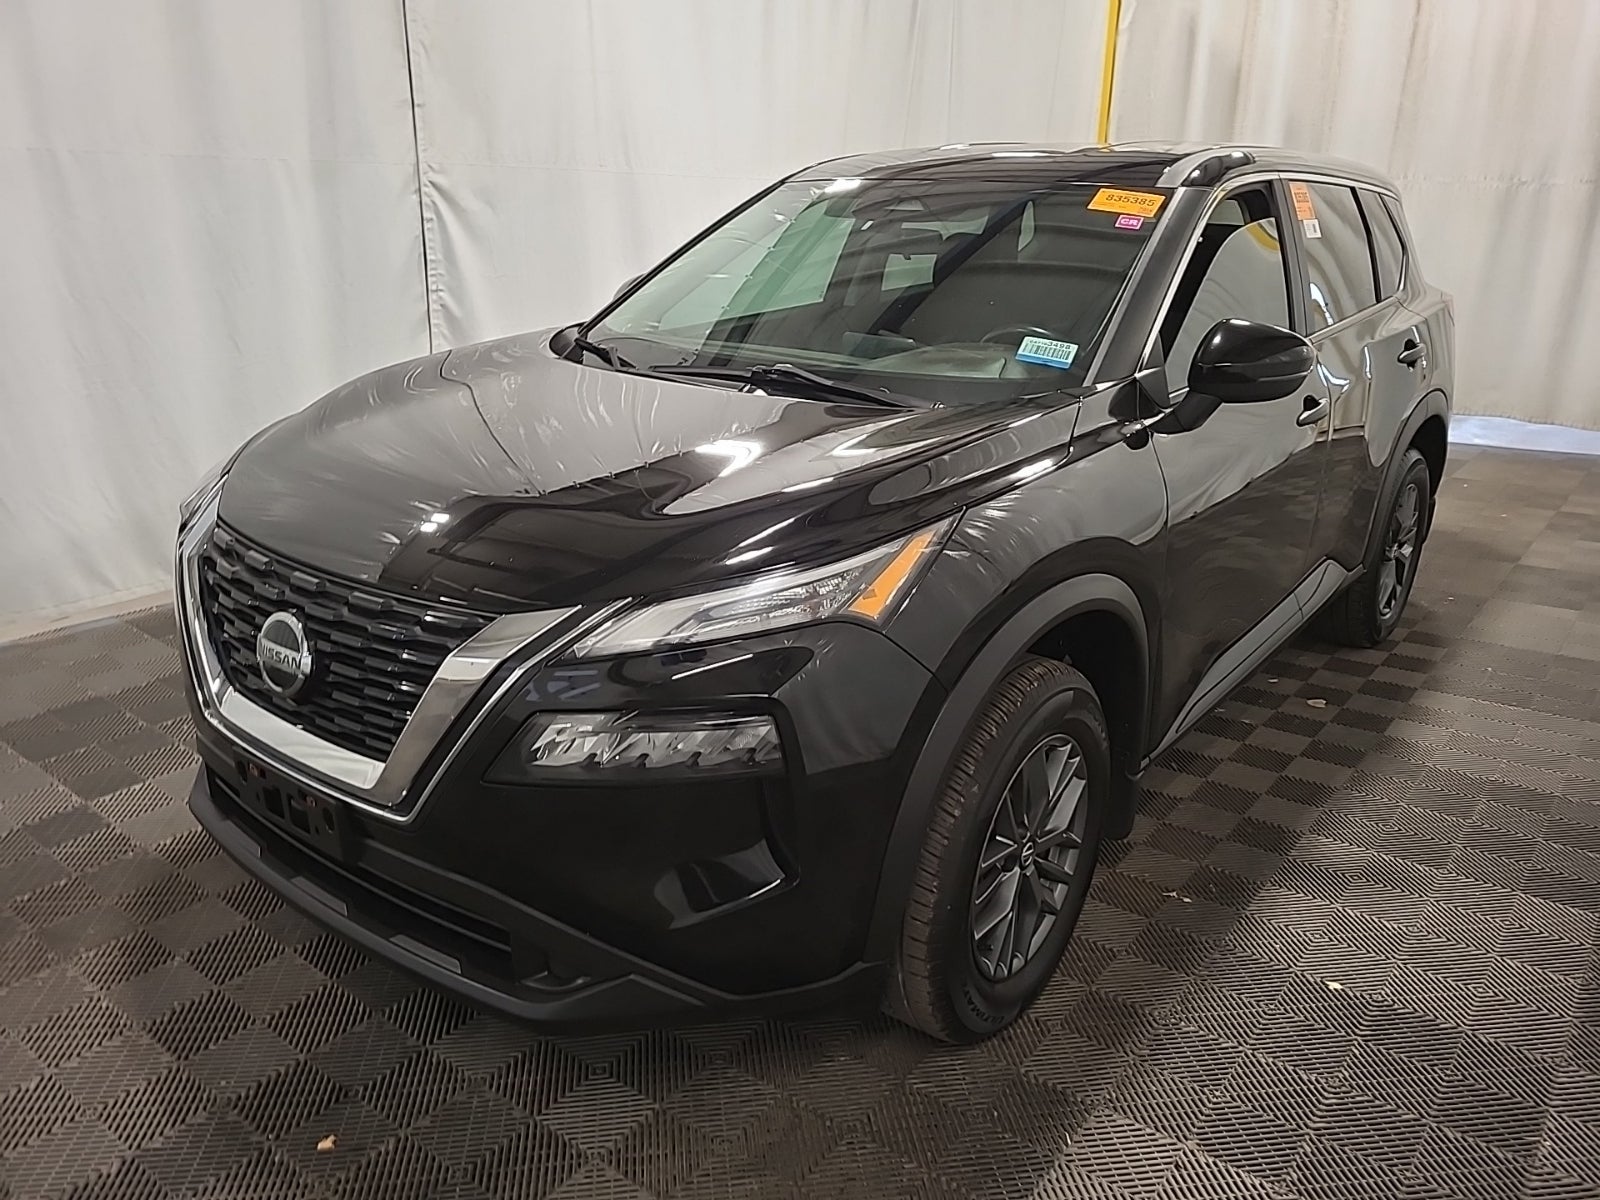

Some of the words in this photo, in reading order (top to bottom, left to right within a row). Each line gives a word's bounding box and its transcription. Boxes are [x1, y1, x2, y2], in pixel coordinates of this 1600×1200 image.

[1106, 193, 1157, 207] 835385
[1120, 217, 1138, 226] CR
[262, 639, 301, 669] NISSAN
